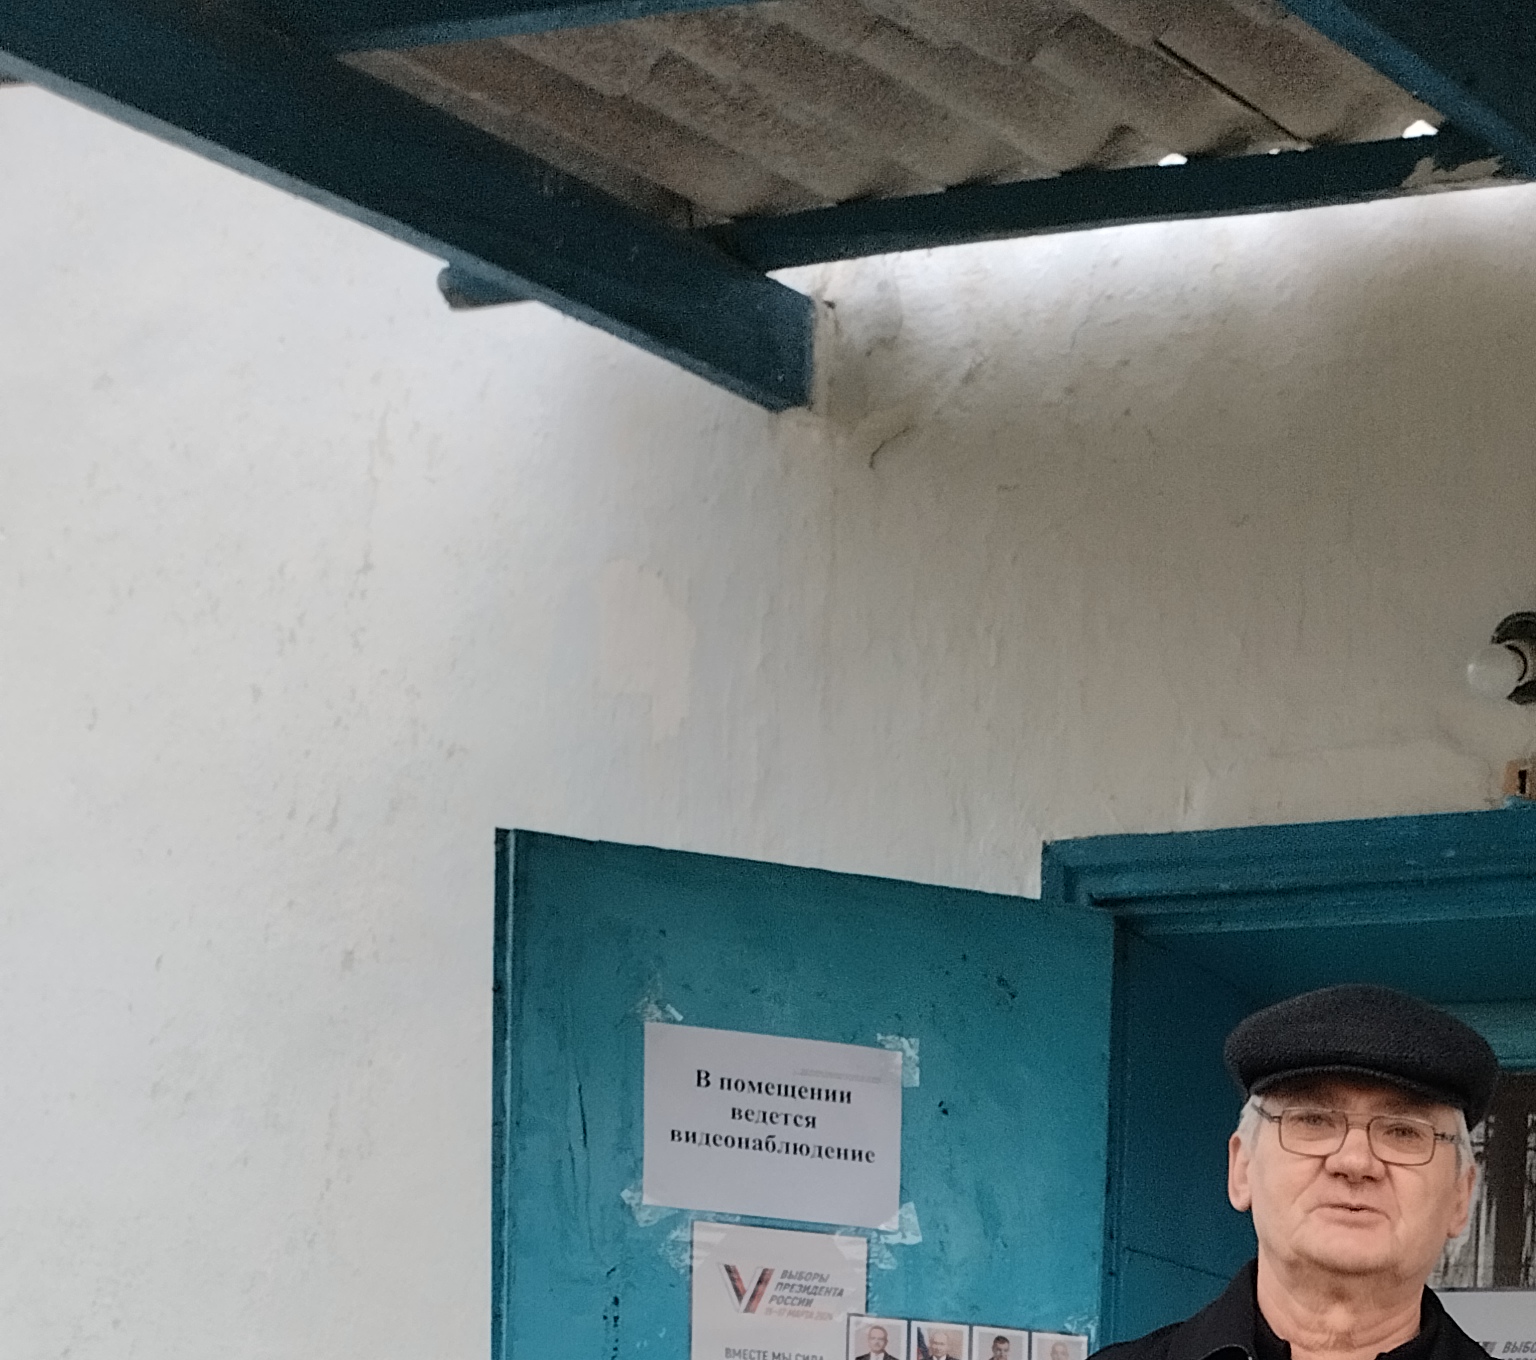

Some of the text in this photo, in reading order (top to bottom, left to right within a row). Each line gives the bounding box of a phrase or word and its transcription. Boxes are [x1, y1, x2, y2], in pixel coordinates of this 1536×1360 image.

[696, 1068, 711, 1088] В
[719, 1076, 852, 1104] помещении
[730, 1106, 817, 1130] ведется
[670, 1128, 876, 1164] видеонаблюдение
[780, 1269, 831, 1283] ВЫБОРЫ
[774, 1281, 845, 1298] ПРЕЗИДЕНТА
[767, 1294, 815, 1308] РОССИИ
